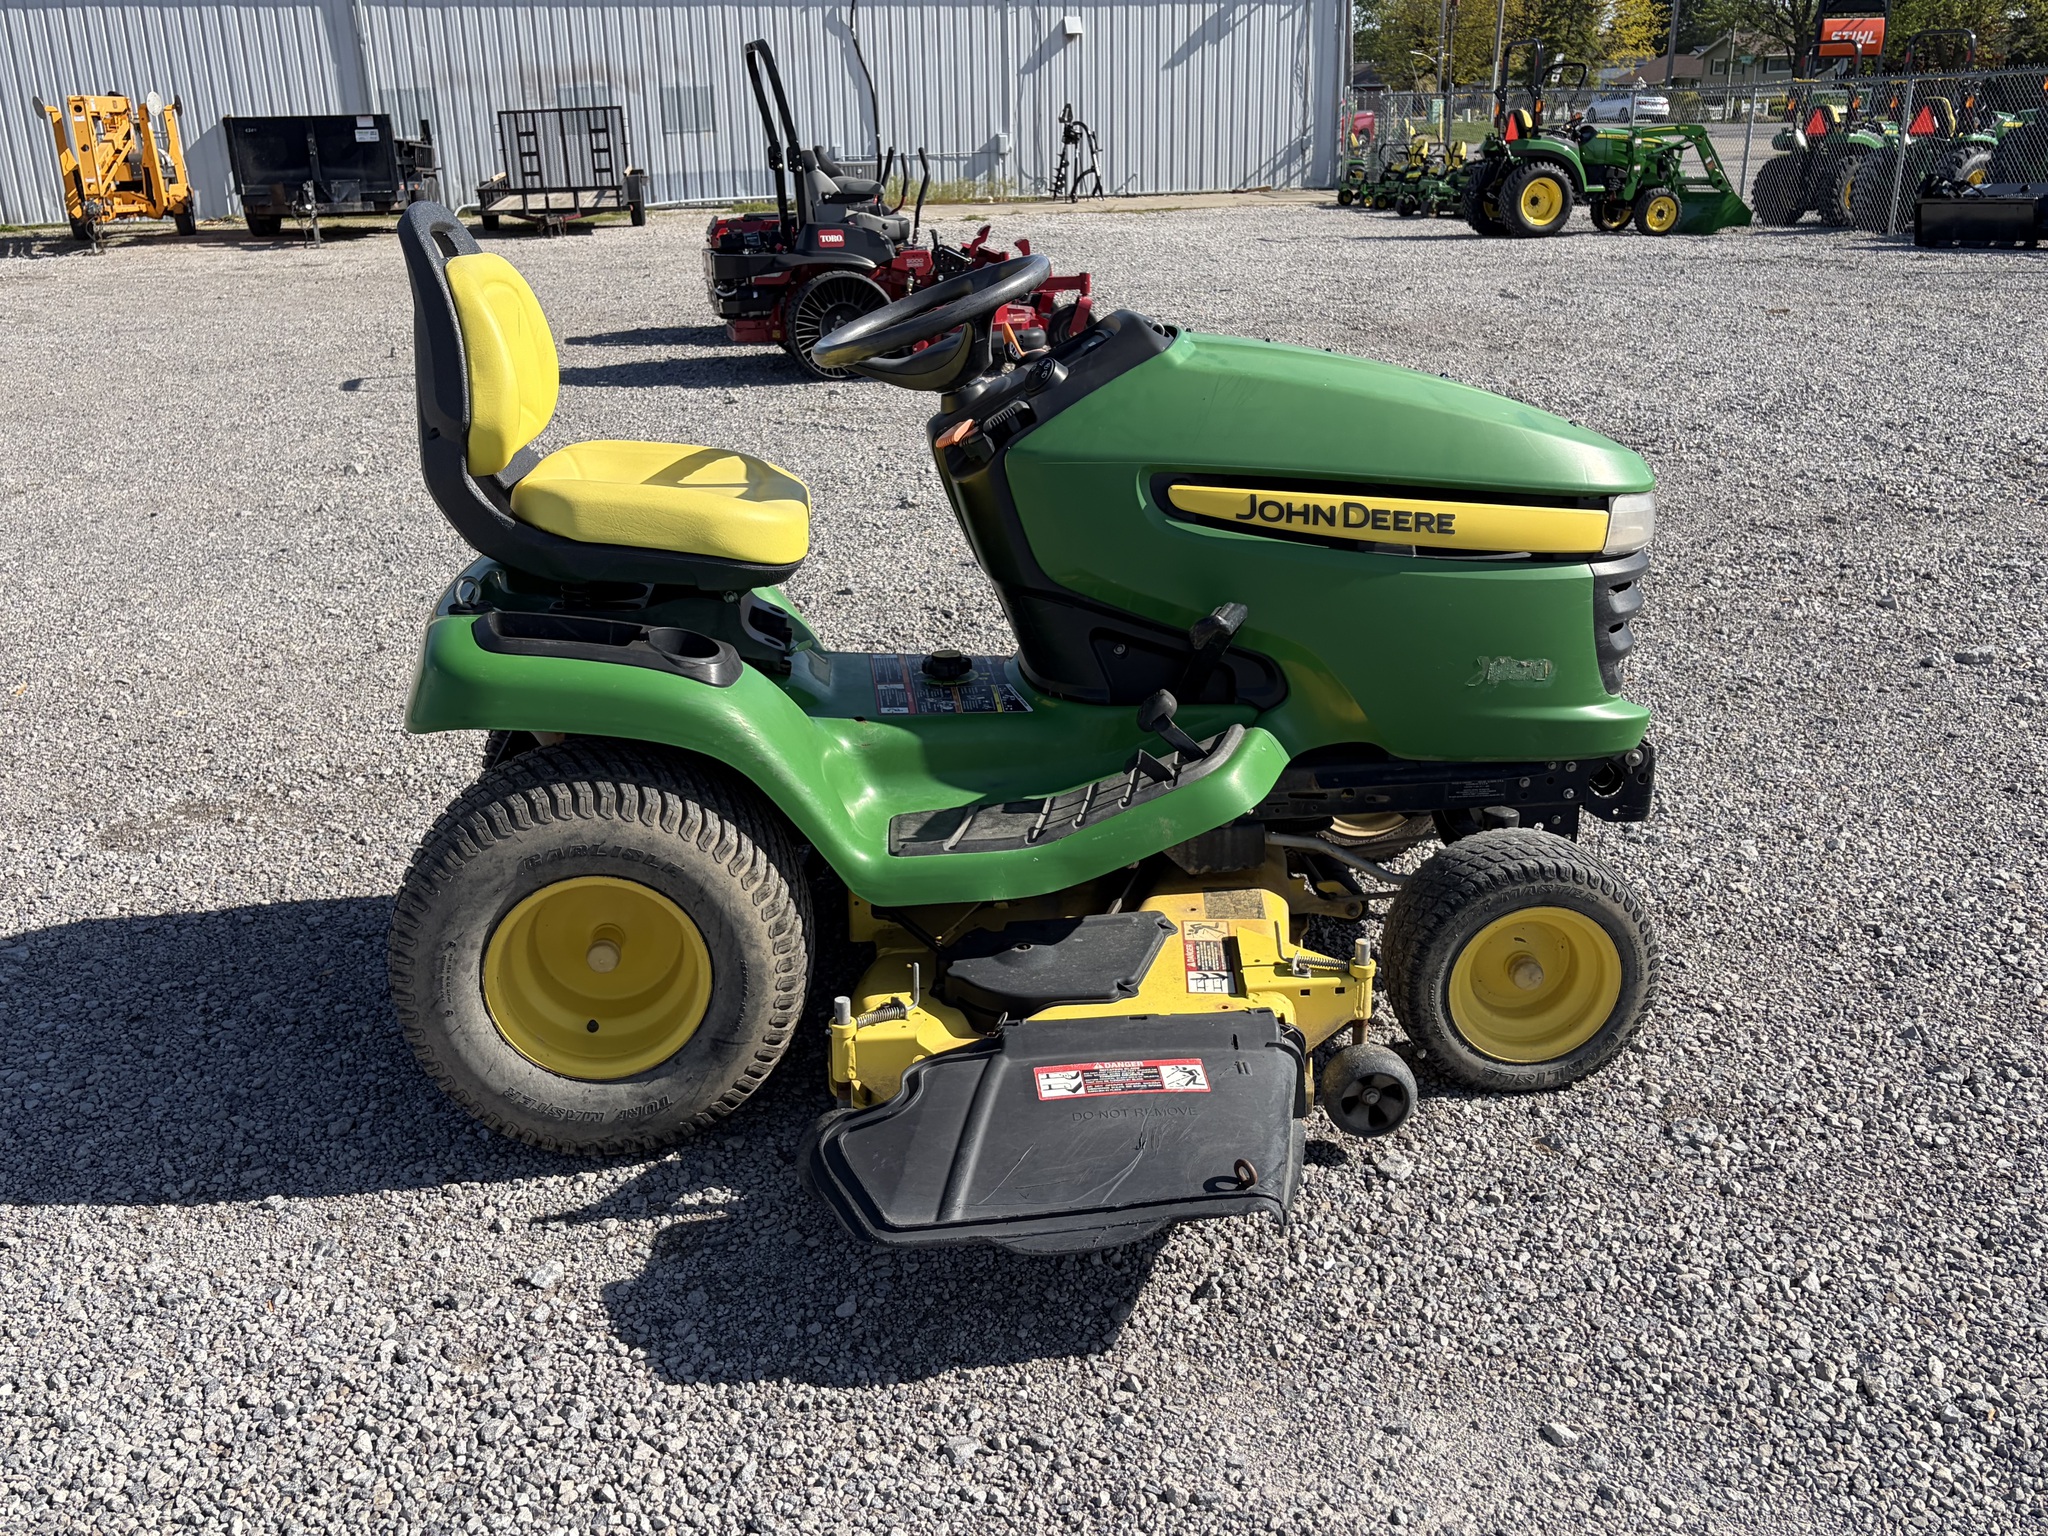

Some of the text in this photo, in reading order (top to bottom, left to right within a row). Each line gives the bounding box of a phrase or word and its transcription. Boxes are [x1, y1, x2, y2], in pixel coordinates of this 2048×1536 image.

[1831, 30, 1877, 44] STIHL
[820, 234, 843, 243] TORO
[1235, 494, 1456, 535] JOHN DEERE
[523, 843, 686, 878] CARLISLE
[1501, 884, 1599, 903] MASTER
[503, 1086, 607, 1123] MASTER
[1072, 1106, 1198, 1121] DO NOT REMOVE
